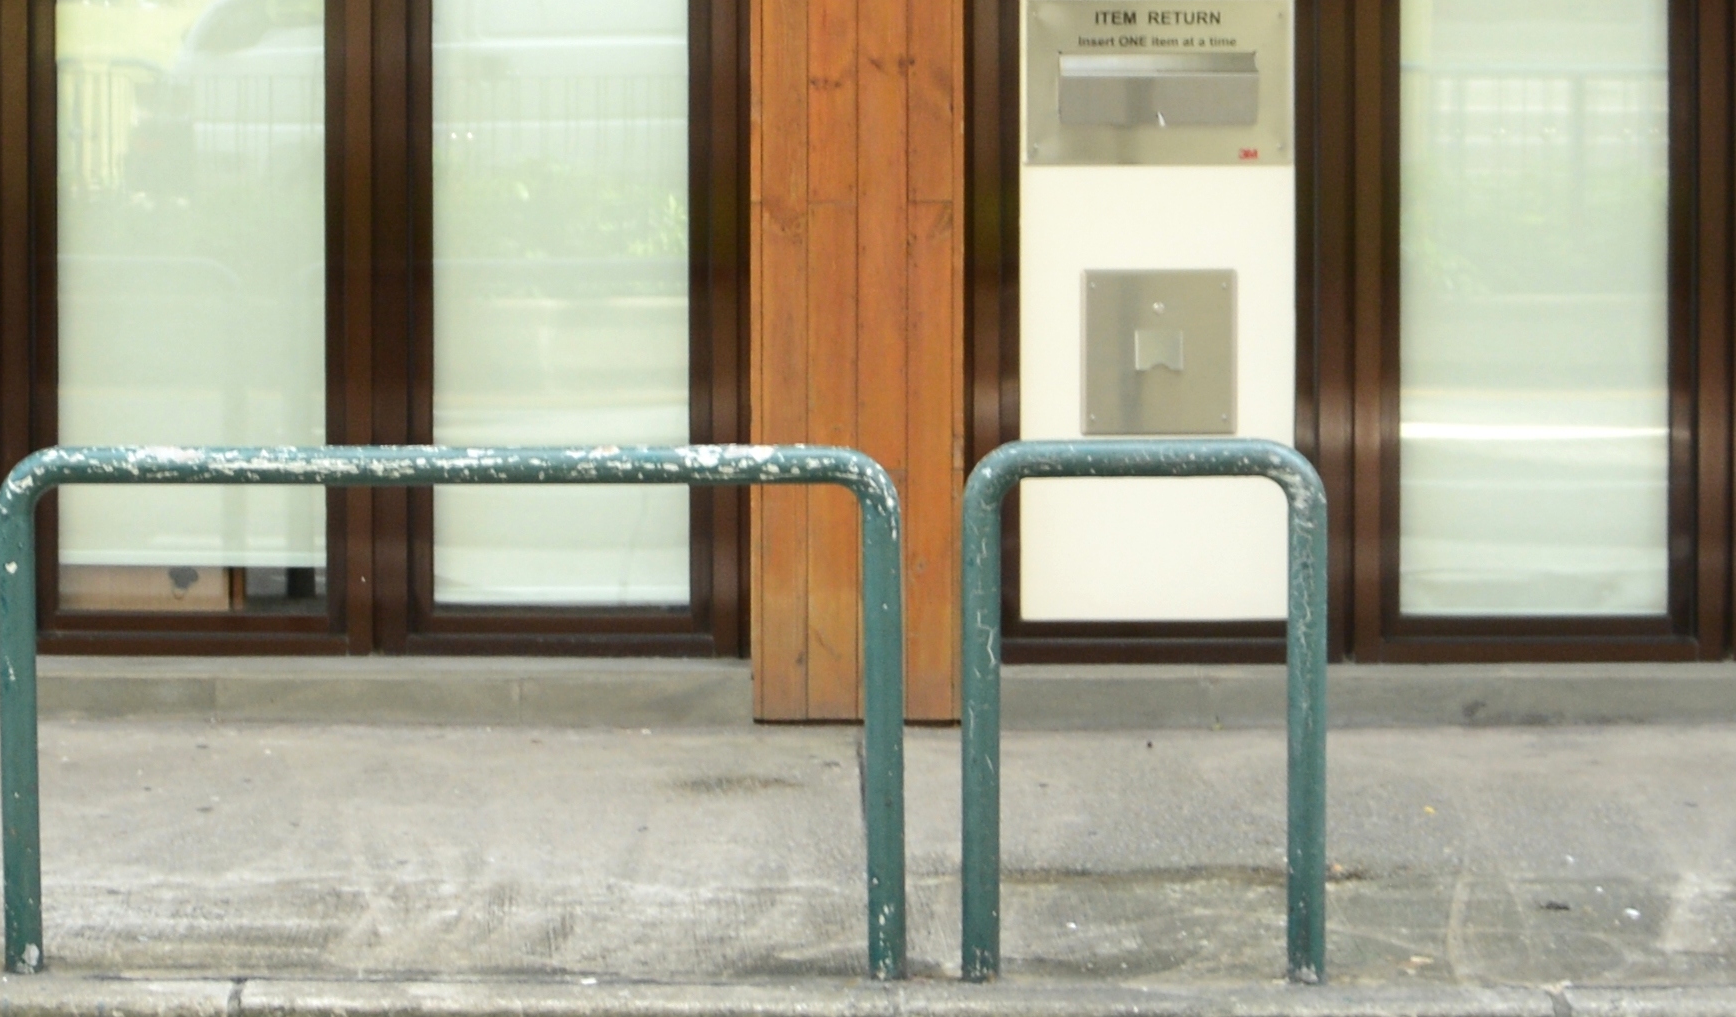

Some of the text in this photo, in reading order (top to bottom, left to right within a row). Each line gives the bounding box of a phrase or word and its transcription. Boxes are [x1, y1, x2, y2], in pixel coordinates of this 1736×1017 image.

[1095, 10, 1222, 26] ITEM RETURN
[1078, 35, 1236, 47] Insert ONE item at a time
[1238, 147, 1259, 160] 3M
